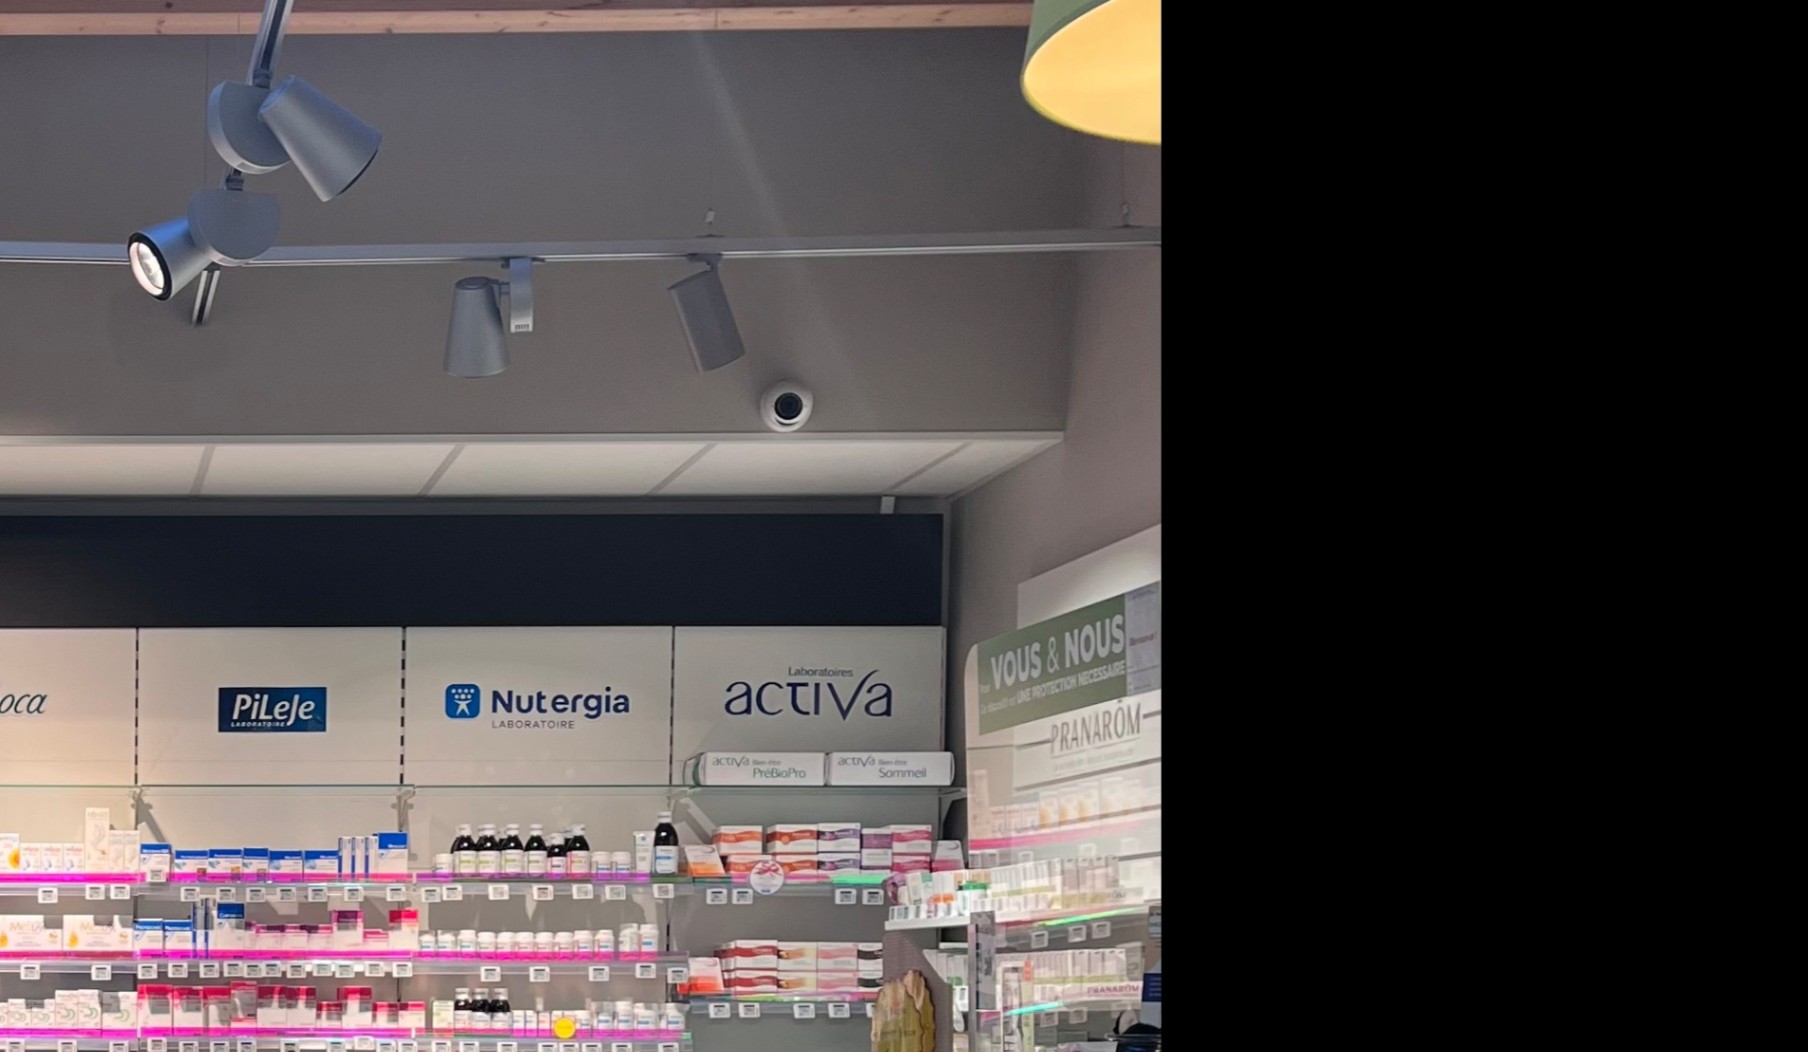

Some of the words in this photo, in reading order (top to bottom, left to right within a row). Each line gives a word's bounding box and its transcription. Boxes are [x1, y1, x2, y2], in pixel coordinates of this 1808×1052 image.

[991, 642, 1042, 690] VOUS
[1047, 636, 1060, 673] &
[1064, 614, 1125, 668] NOUS
[788, 667, 854, 677] Laboratoires
[1016, 688, 1032, 704] UNE
[1032, 674, 1077, 700] PROTECTION
[232, 693, 316, 726] PiLeJe
[491, 686, 630, 719] Nutergia
[492, 720, 575, 729] LABORATOIRE
[753, 768, 807, 779] PréBioPro
[878, 767, 927, 779] Sommeil
